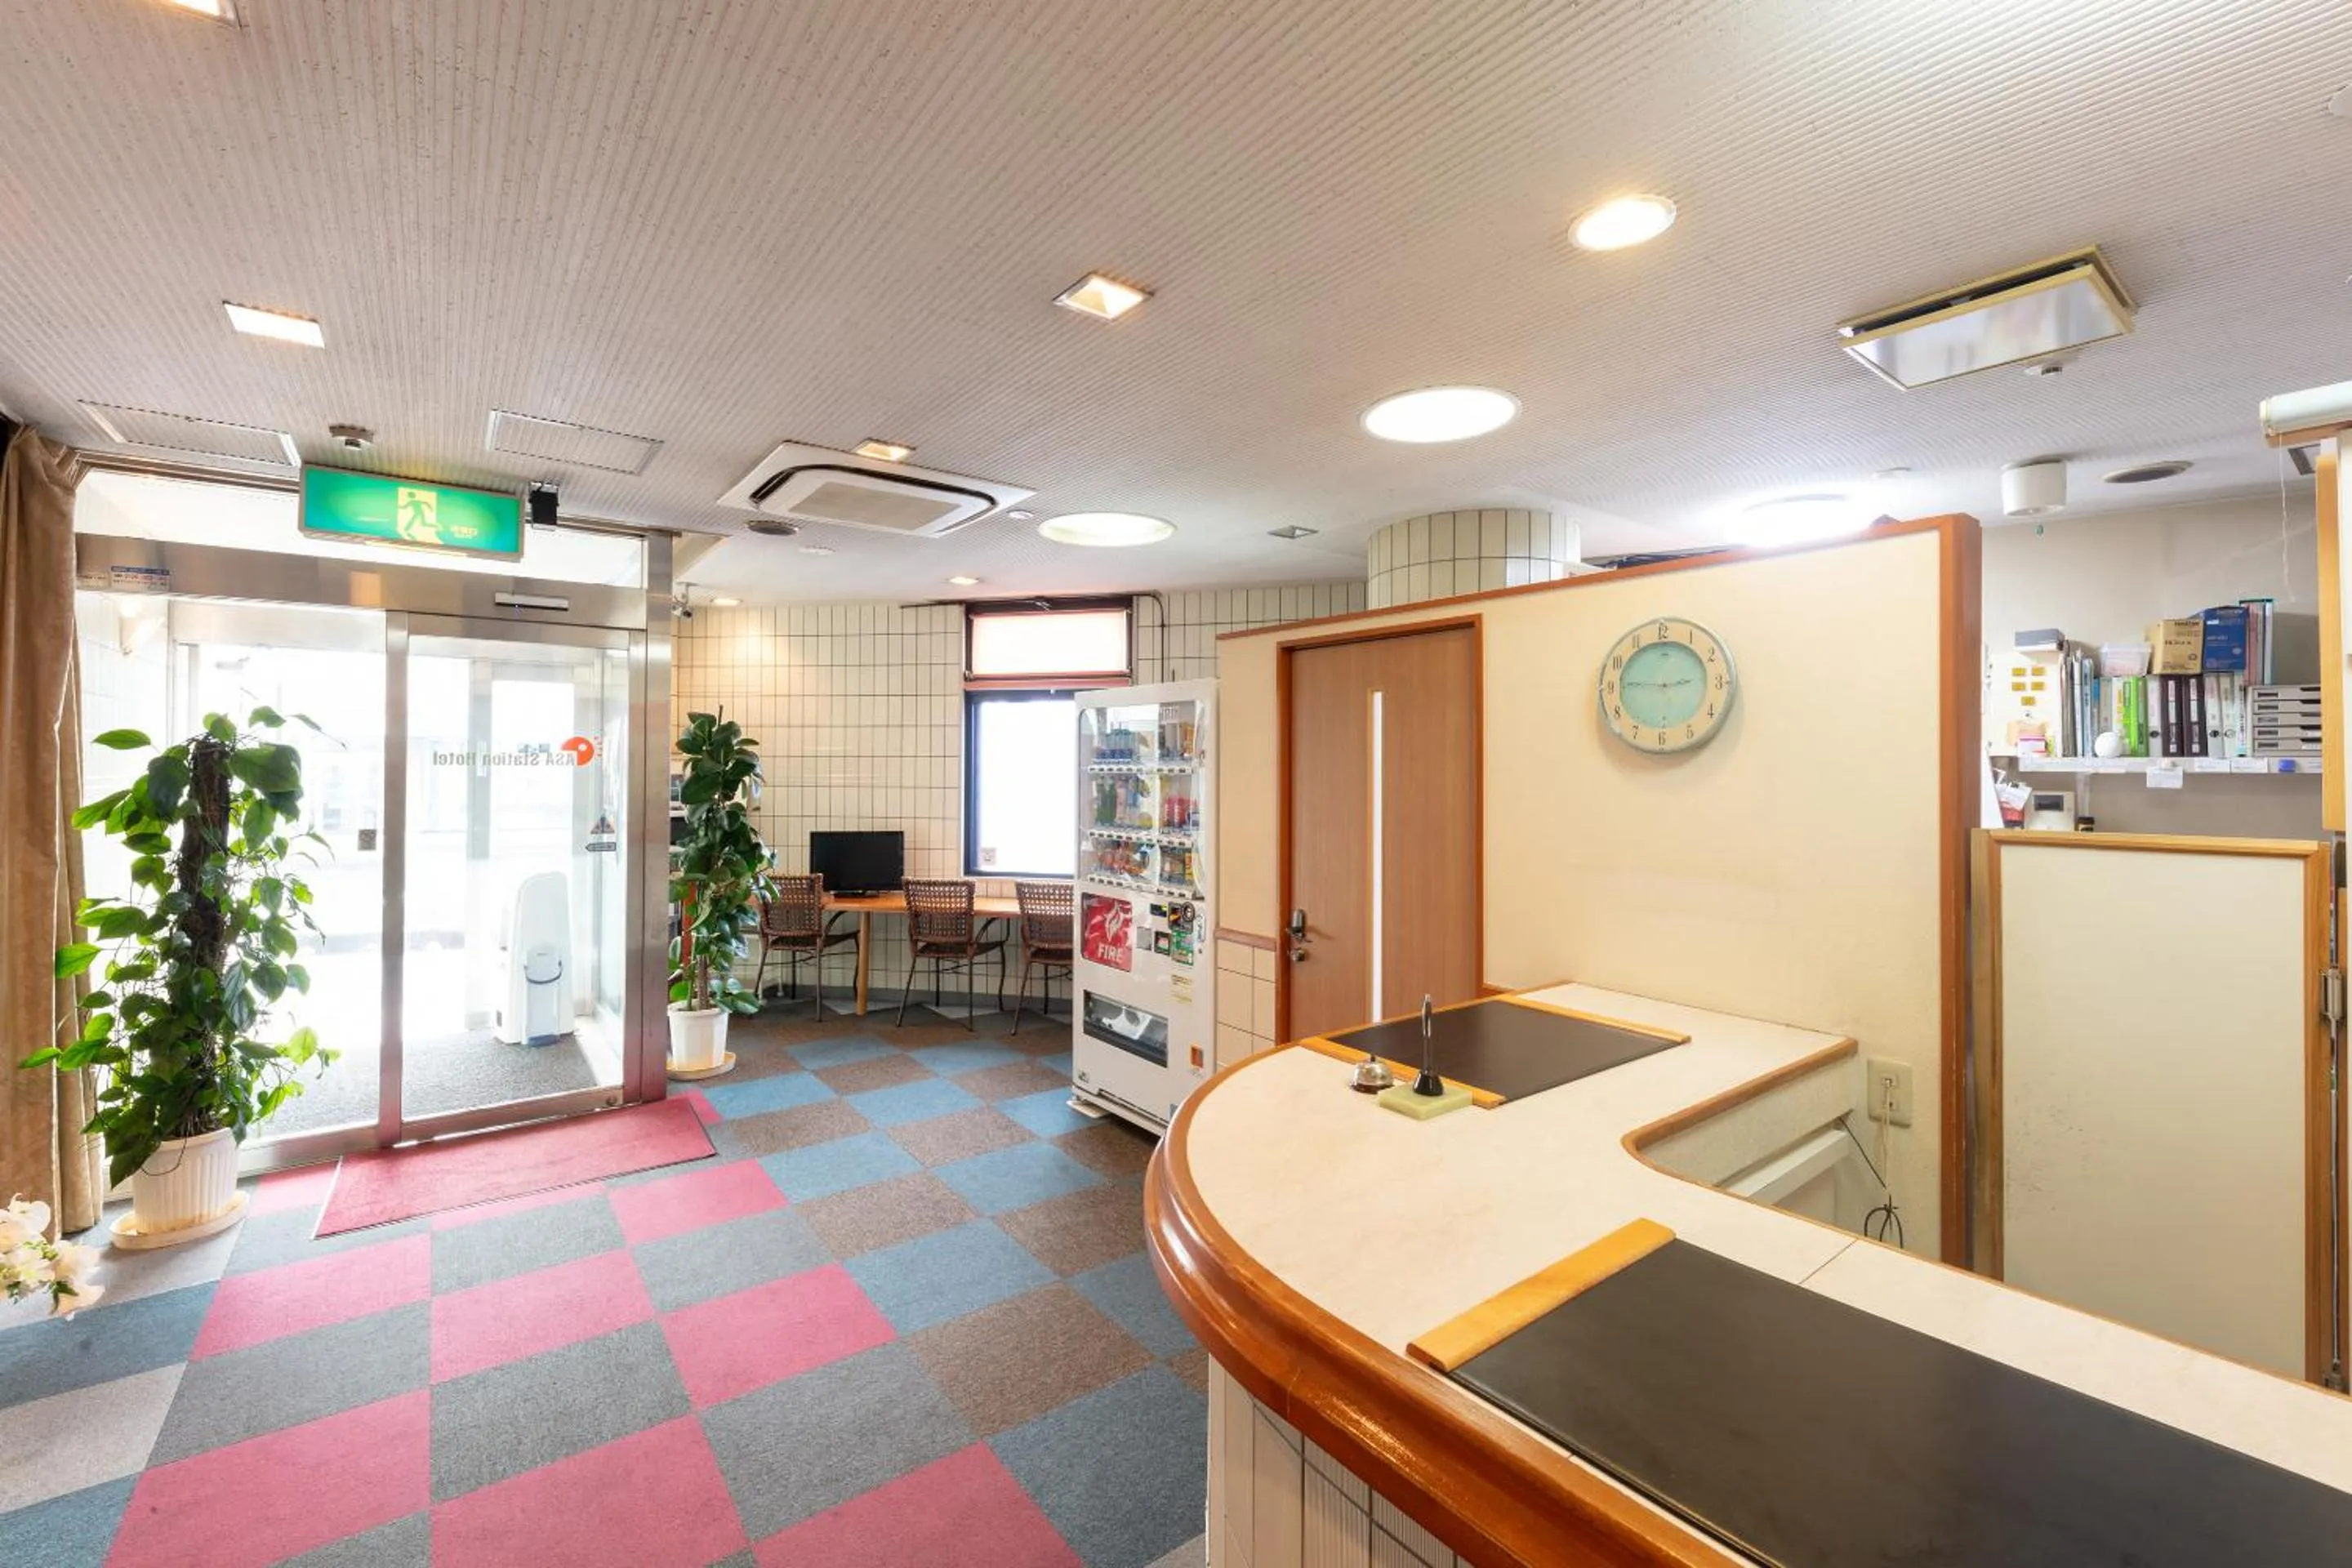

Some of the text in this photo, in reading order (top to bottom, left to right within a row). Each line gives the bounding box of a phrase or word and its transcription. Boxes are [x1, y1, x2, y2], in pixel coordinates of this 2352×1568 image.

[1658, 622, 1669, 640] 12
[1632, 634, 1640, 648] 11
[1707, 647, 1716, 663] 2
[1613, 656, 1623, 670] 10
[1606, 681, 1615, 695] 9
[1715, 675, 1723, 690] 3
[1613, 706, 1621, 720] 8
[1707, 703, 1714, 719] 4
[1633, 725, 1639, 739] 7
[1686, 724, 1694, 739] 5
[1658, 732, 1666, 746] 6
[1097, 942, 1125, 963] FIRE
